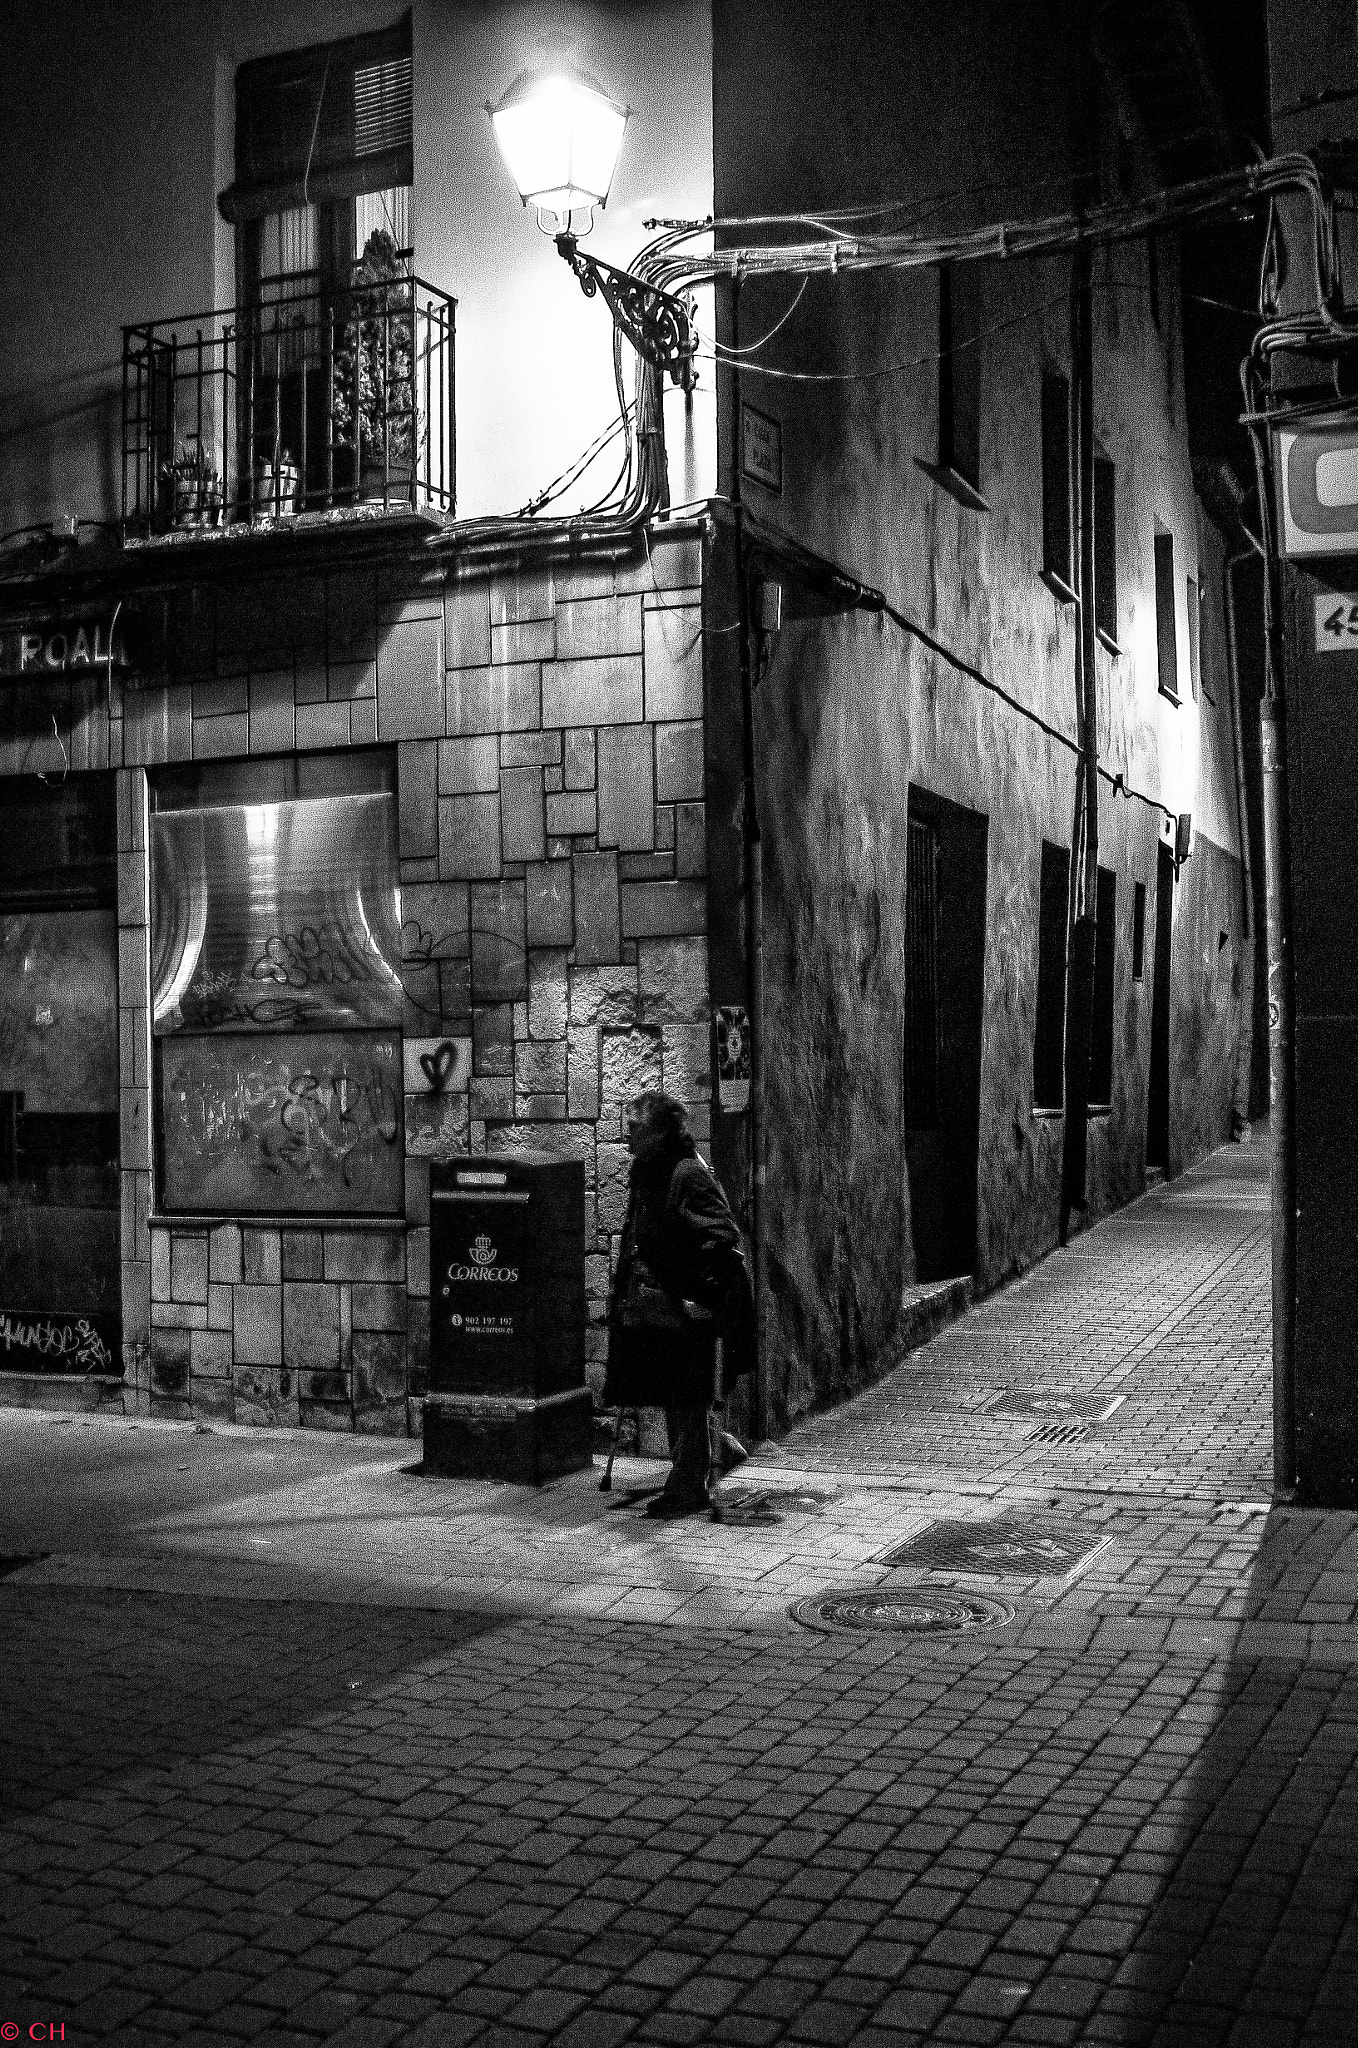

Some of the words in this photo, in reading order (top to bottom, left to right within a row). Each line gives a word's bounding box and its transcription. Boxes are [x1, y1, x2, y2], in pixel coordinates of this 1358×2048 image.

[448, 1263, 520, 1283] CORREOS
[465, 1316, 480, 1325] 902
[482, 1317, 496, 1325] 197
[499, 1317, 513, 1326] 197
[465, 1326, 514, 1334] www.correos.es
